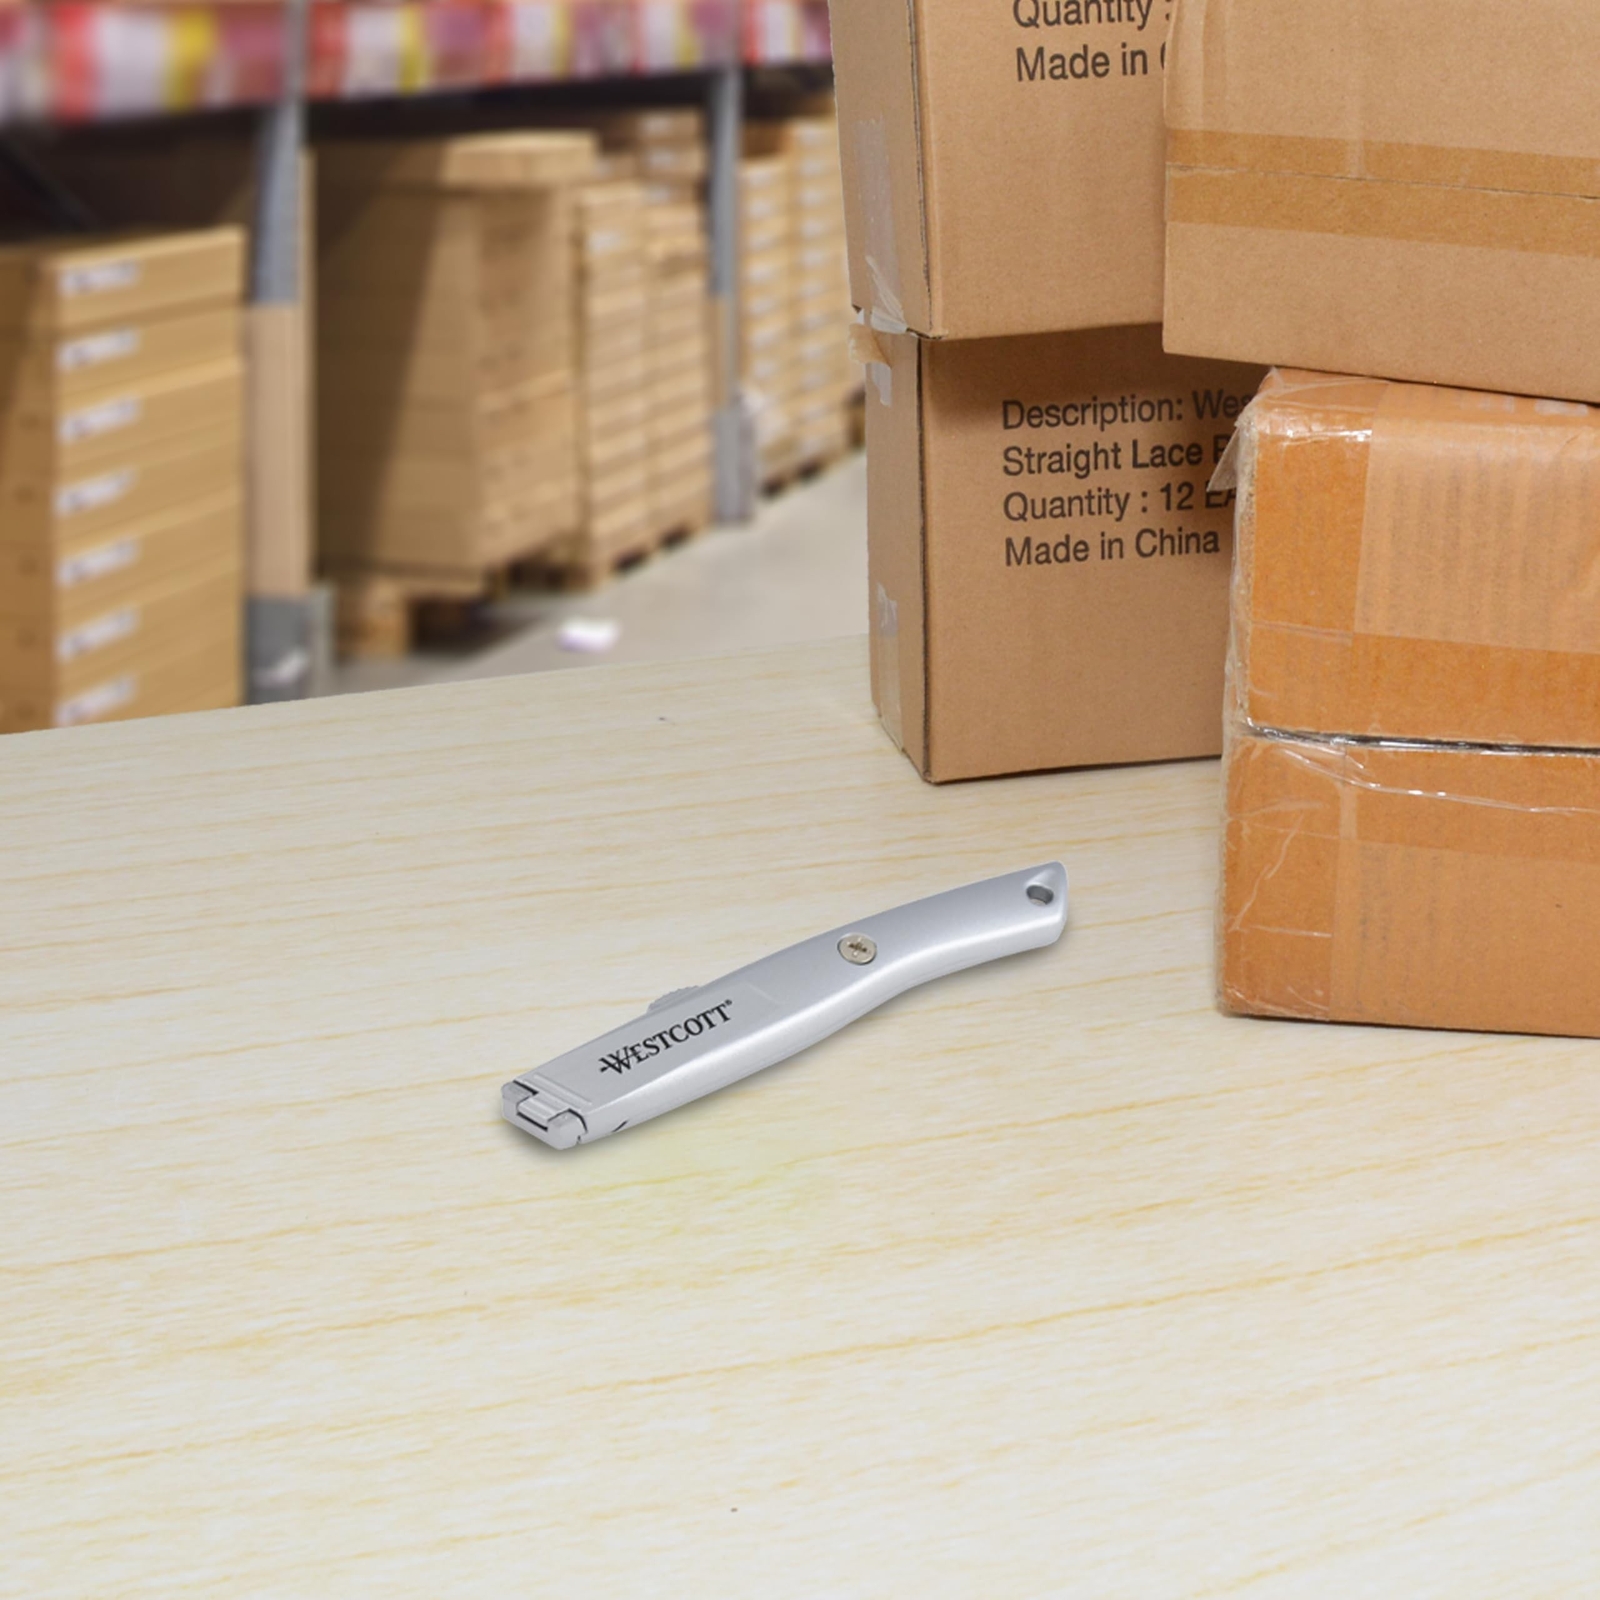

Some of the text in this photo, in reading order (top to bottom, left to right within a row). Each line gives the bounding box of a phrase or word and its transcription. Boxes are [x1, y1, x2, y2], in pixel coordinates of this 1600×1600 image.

[1013, 0, 1152, 31] Quantity
[1016, 44, 1110, 82] Made
[1121, 42, 1148, 76] in
[1002, 394, 1183, 432] Description:
[1003, 442, 1122, 479] Straight
[1132, 439, 1203, 469] Lace
[1003, 487, 1130, 522] Quantity
[1160, 482, 1194, 511] 12
[1005, 527, 1220, 567] Made in China
